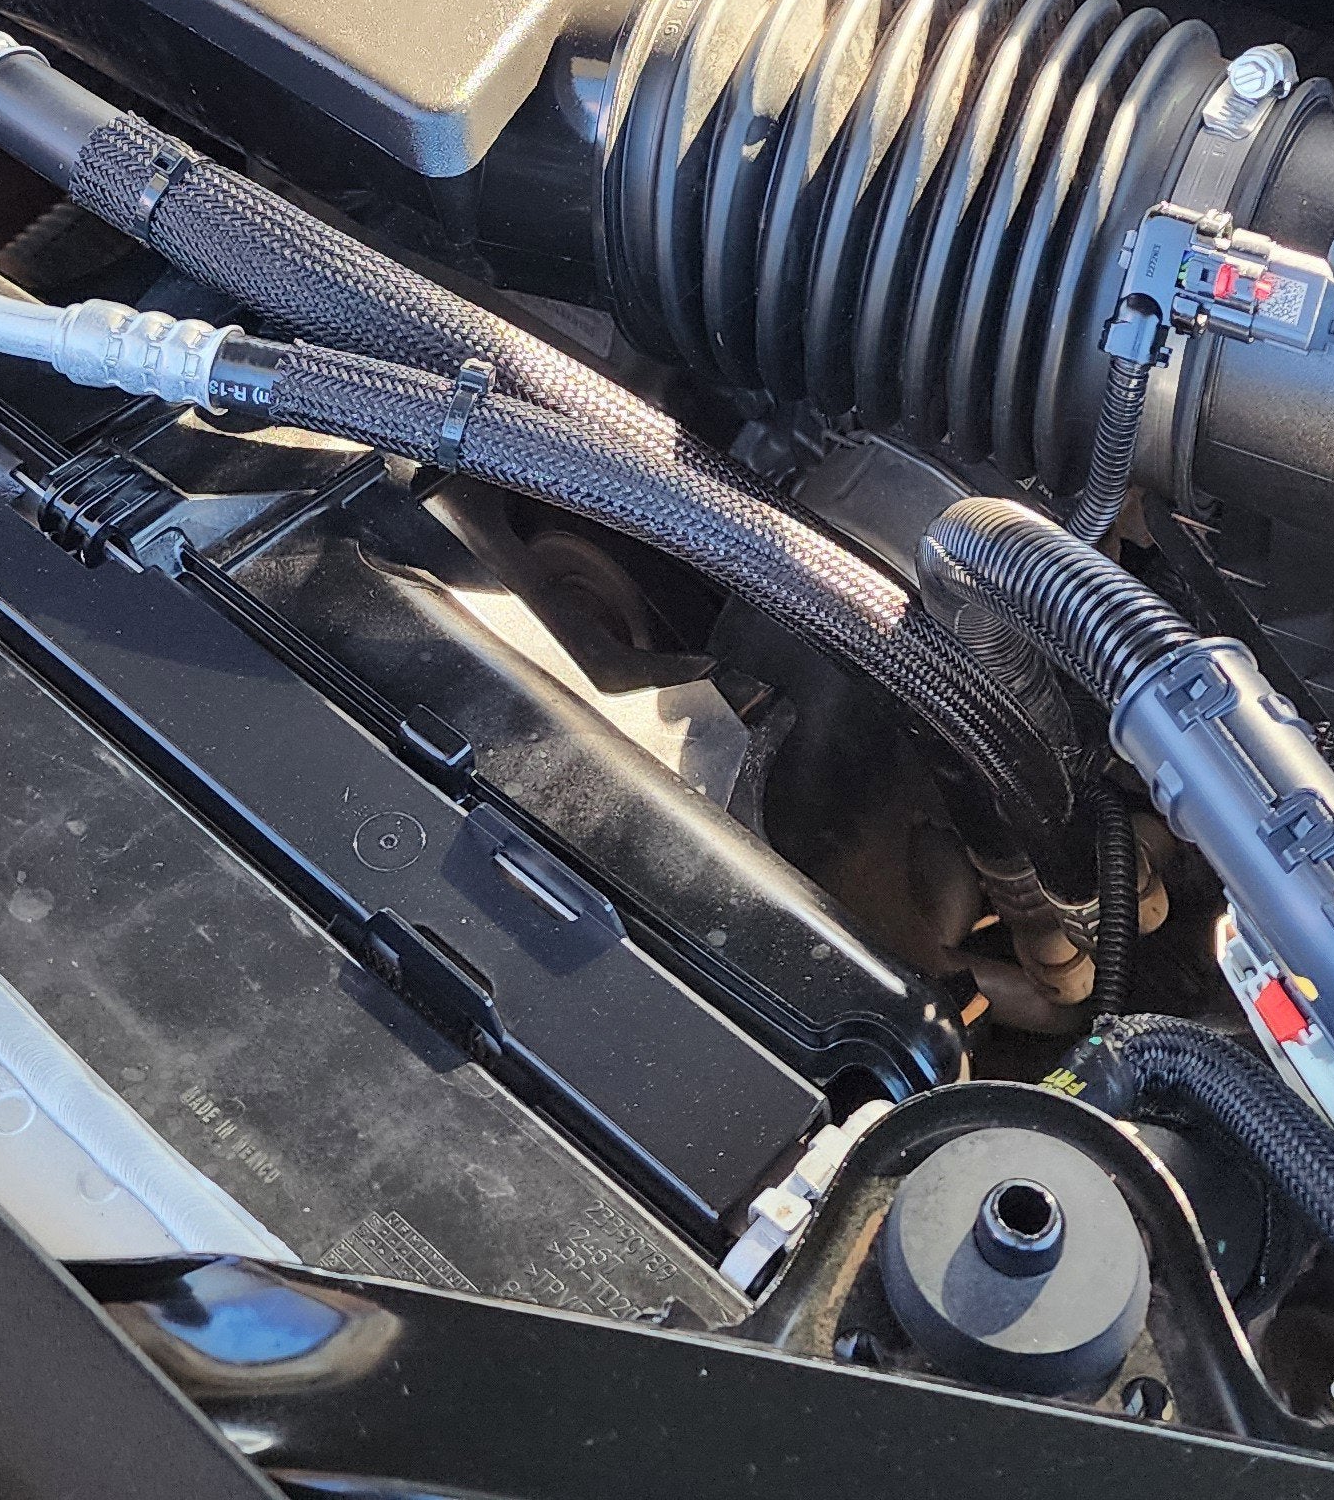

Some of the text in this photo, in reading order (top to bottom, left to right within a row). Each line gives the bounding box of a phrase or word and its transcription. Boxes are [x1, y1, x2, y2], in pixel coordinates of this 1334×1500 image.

[180, 1085, 283, 1184] MADE IN MEXICO
